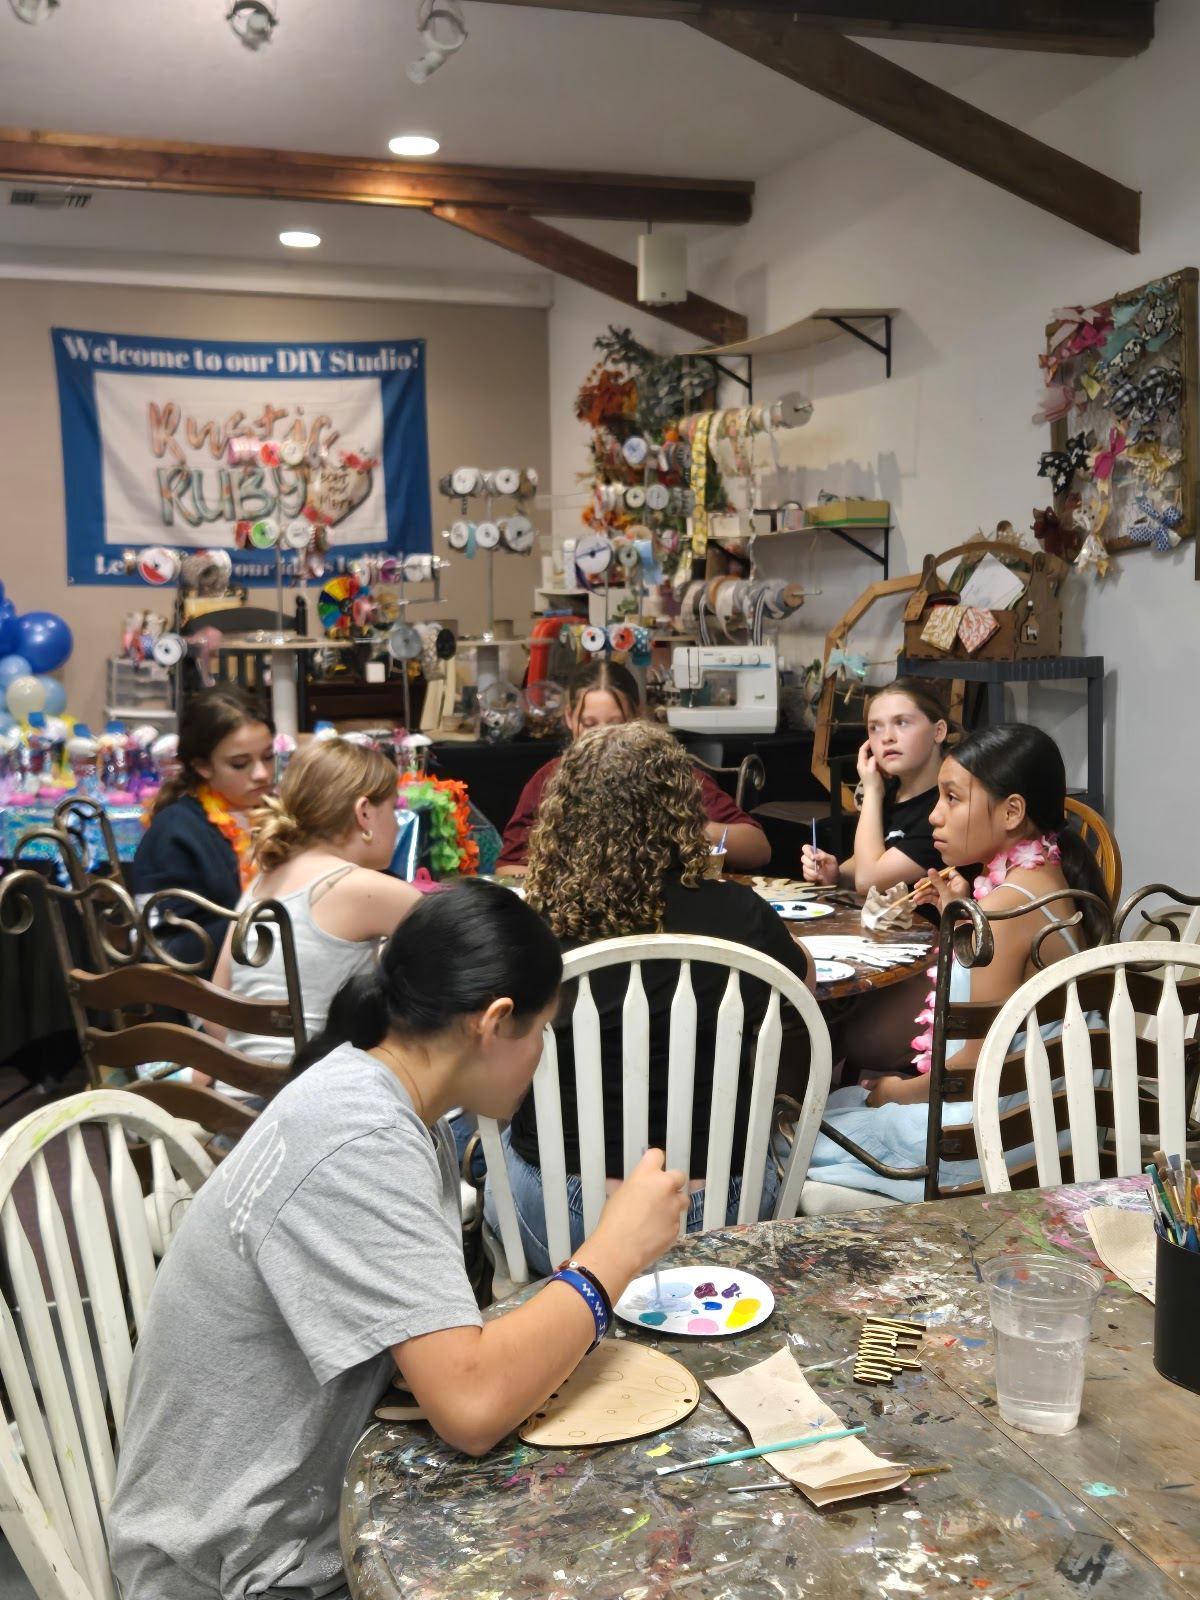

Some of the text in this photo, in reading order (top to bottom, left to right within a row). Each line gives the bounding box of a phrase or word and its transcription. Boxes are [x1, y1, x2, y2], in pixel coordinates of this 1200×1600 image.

[62, 334, 419, 373] Welcome to our DIY Studio!
